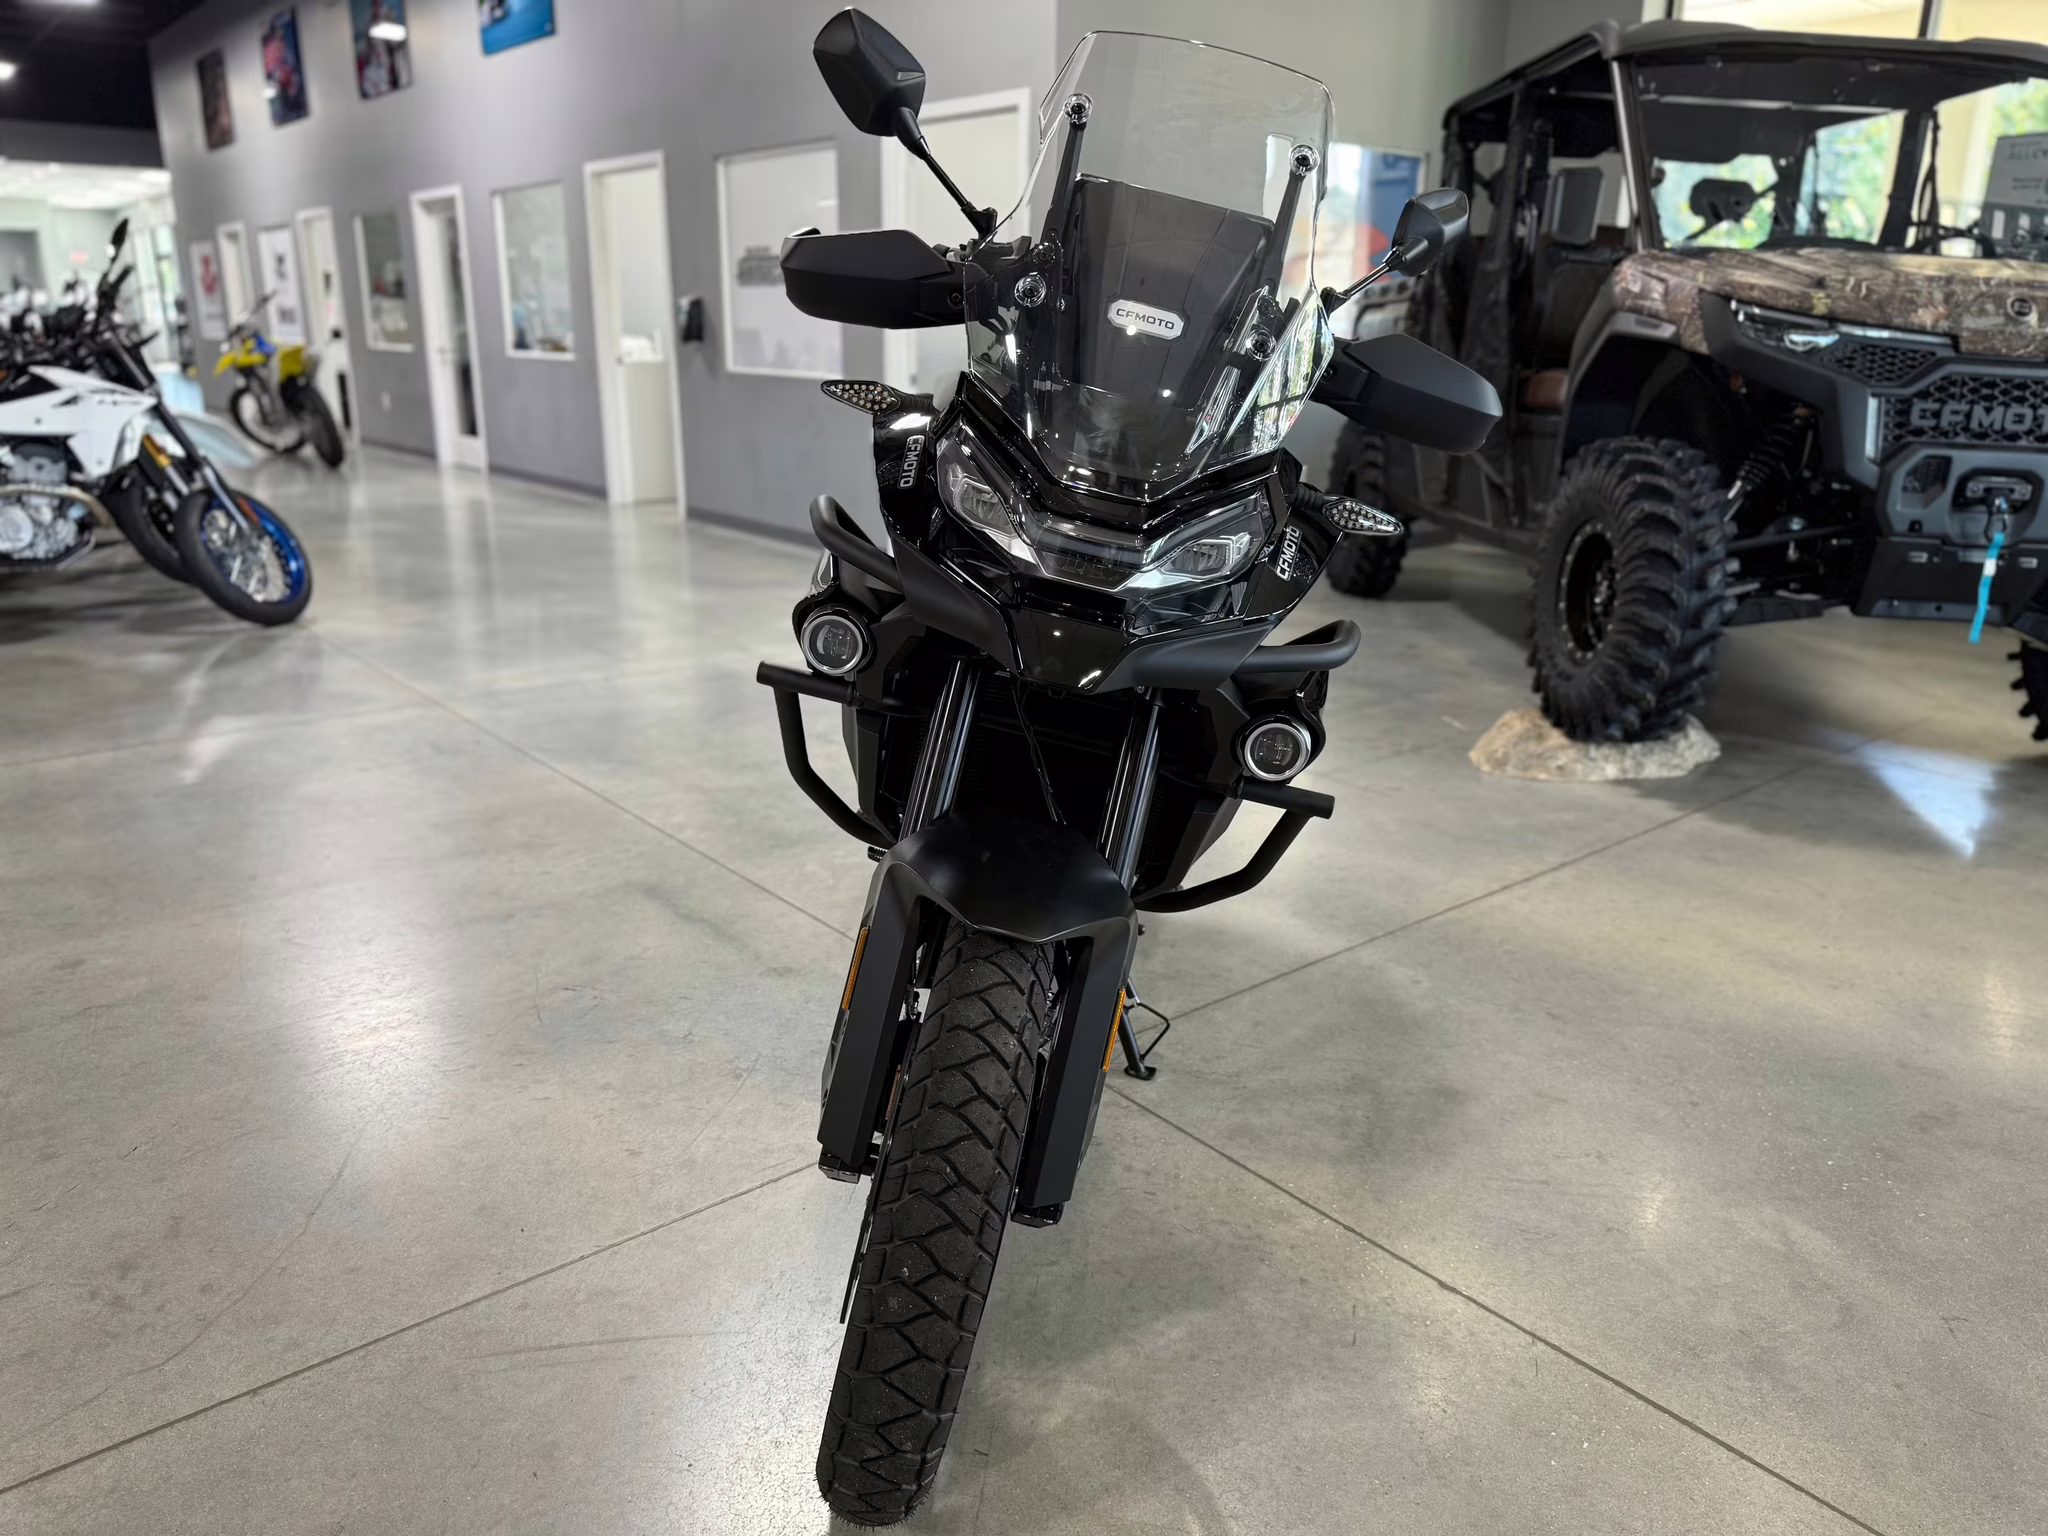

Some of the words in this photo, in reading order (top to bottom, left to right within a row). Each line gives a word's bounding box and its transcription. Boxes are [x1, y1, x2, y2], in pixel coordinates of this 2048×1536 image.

[1115, 308, 1175, 330] CFMOTO
[899, 436, 923, 488] CFMOTO
[1276, 525, 1300, 580] CFMOTO
